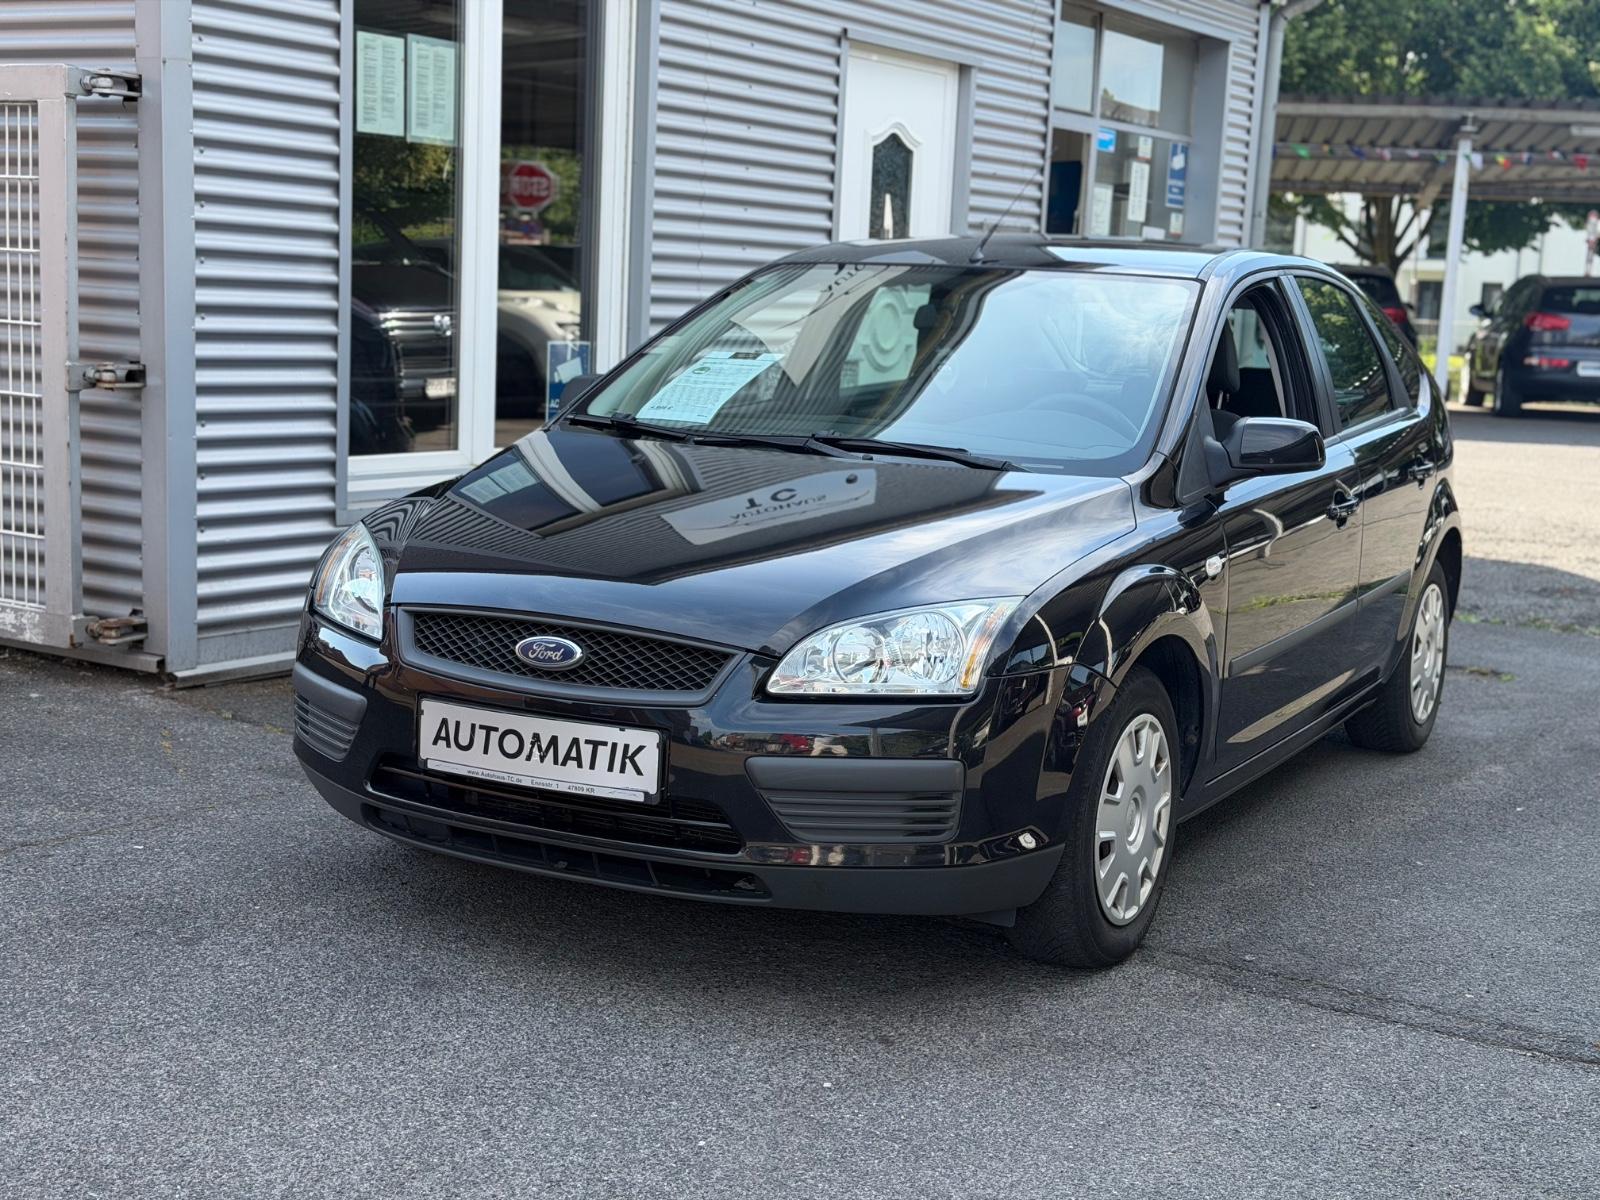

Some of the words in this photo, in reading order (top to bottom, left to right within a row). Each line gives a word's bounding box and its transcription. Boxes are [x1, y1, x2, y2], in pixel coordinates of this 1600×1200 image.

[528, 641, 565, 661] Ford
[431, 717, 647, 777] AUTOMATIK
[586, 786, 596, 794] KR
